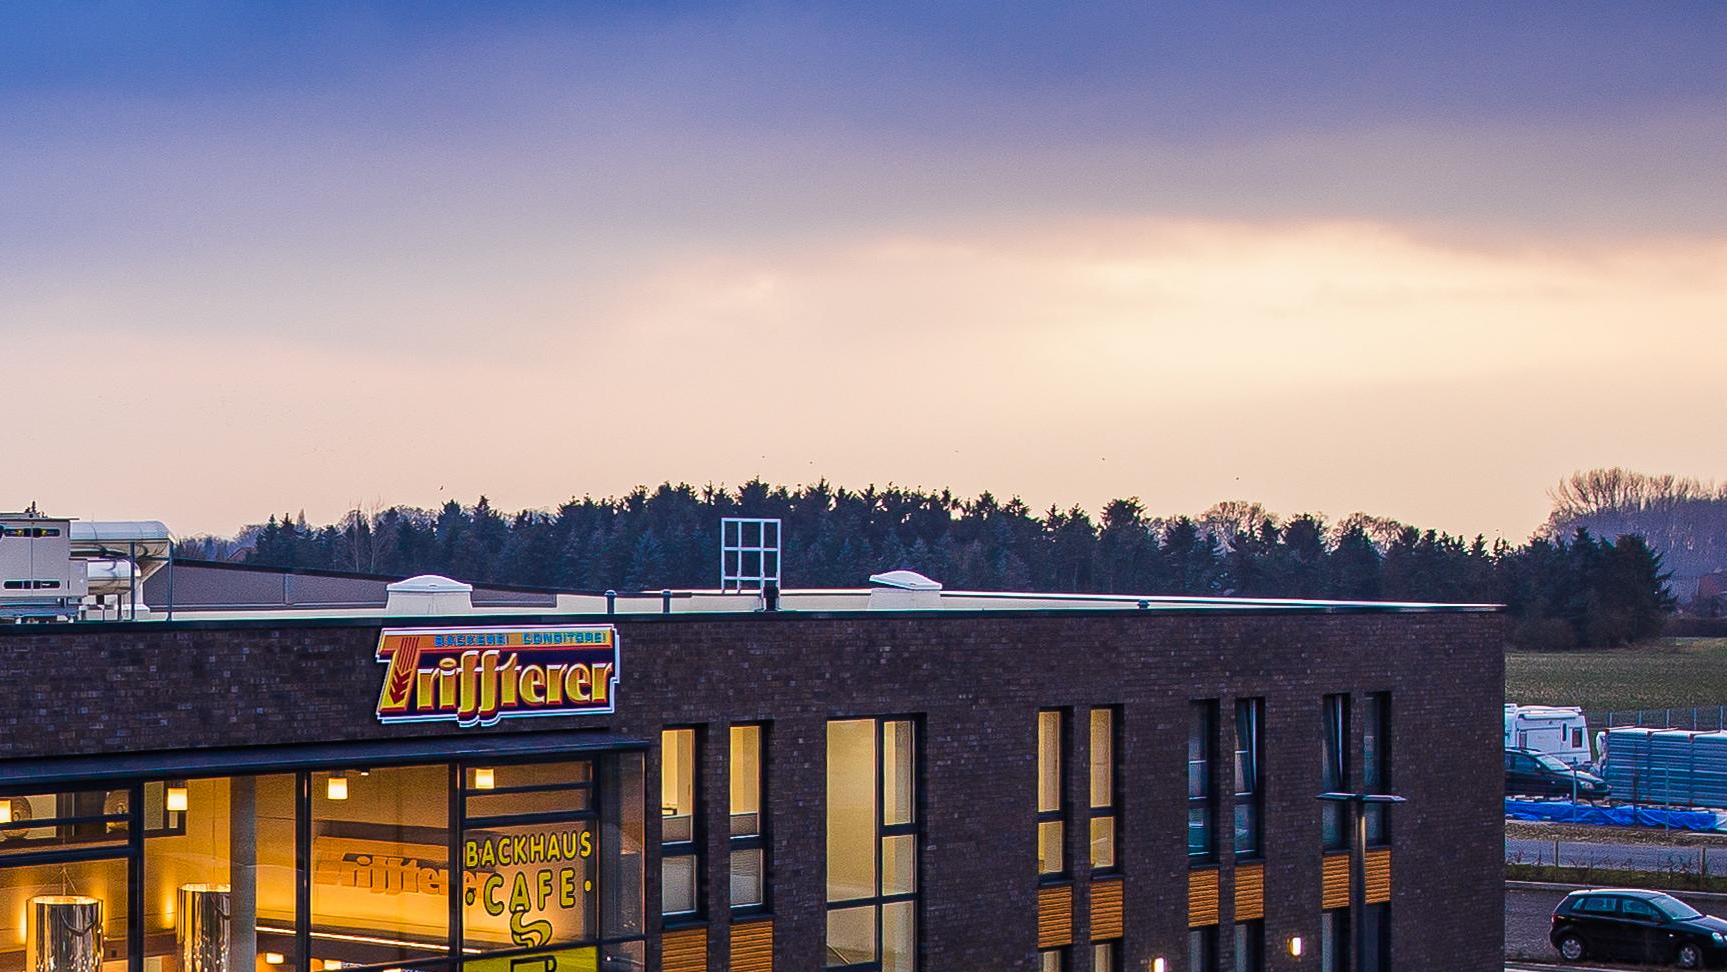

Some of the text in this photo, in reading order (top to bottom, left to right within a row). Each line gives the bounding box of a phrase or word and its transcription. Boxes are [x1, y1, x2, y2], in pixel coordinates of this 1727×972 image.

[523, 631, 607, 645] CONDITOREI
[464, 830, 593, 868] BACKHAUS
[483, 867, 576, 917] CAFE
